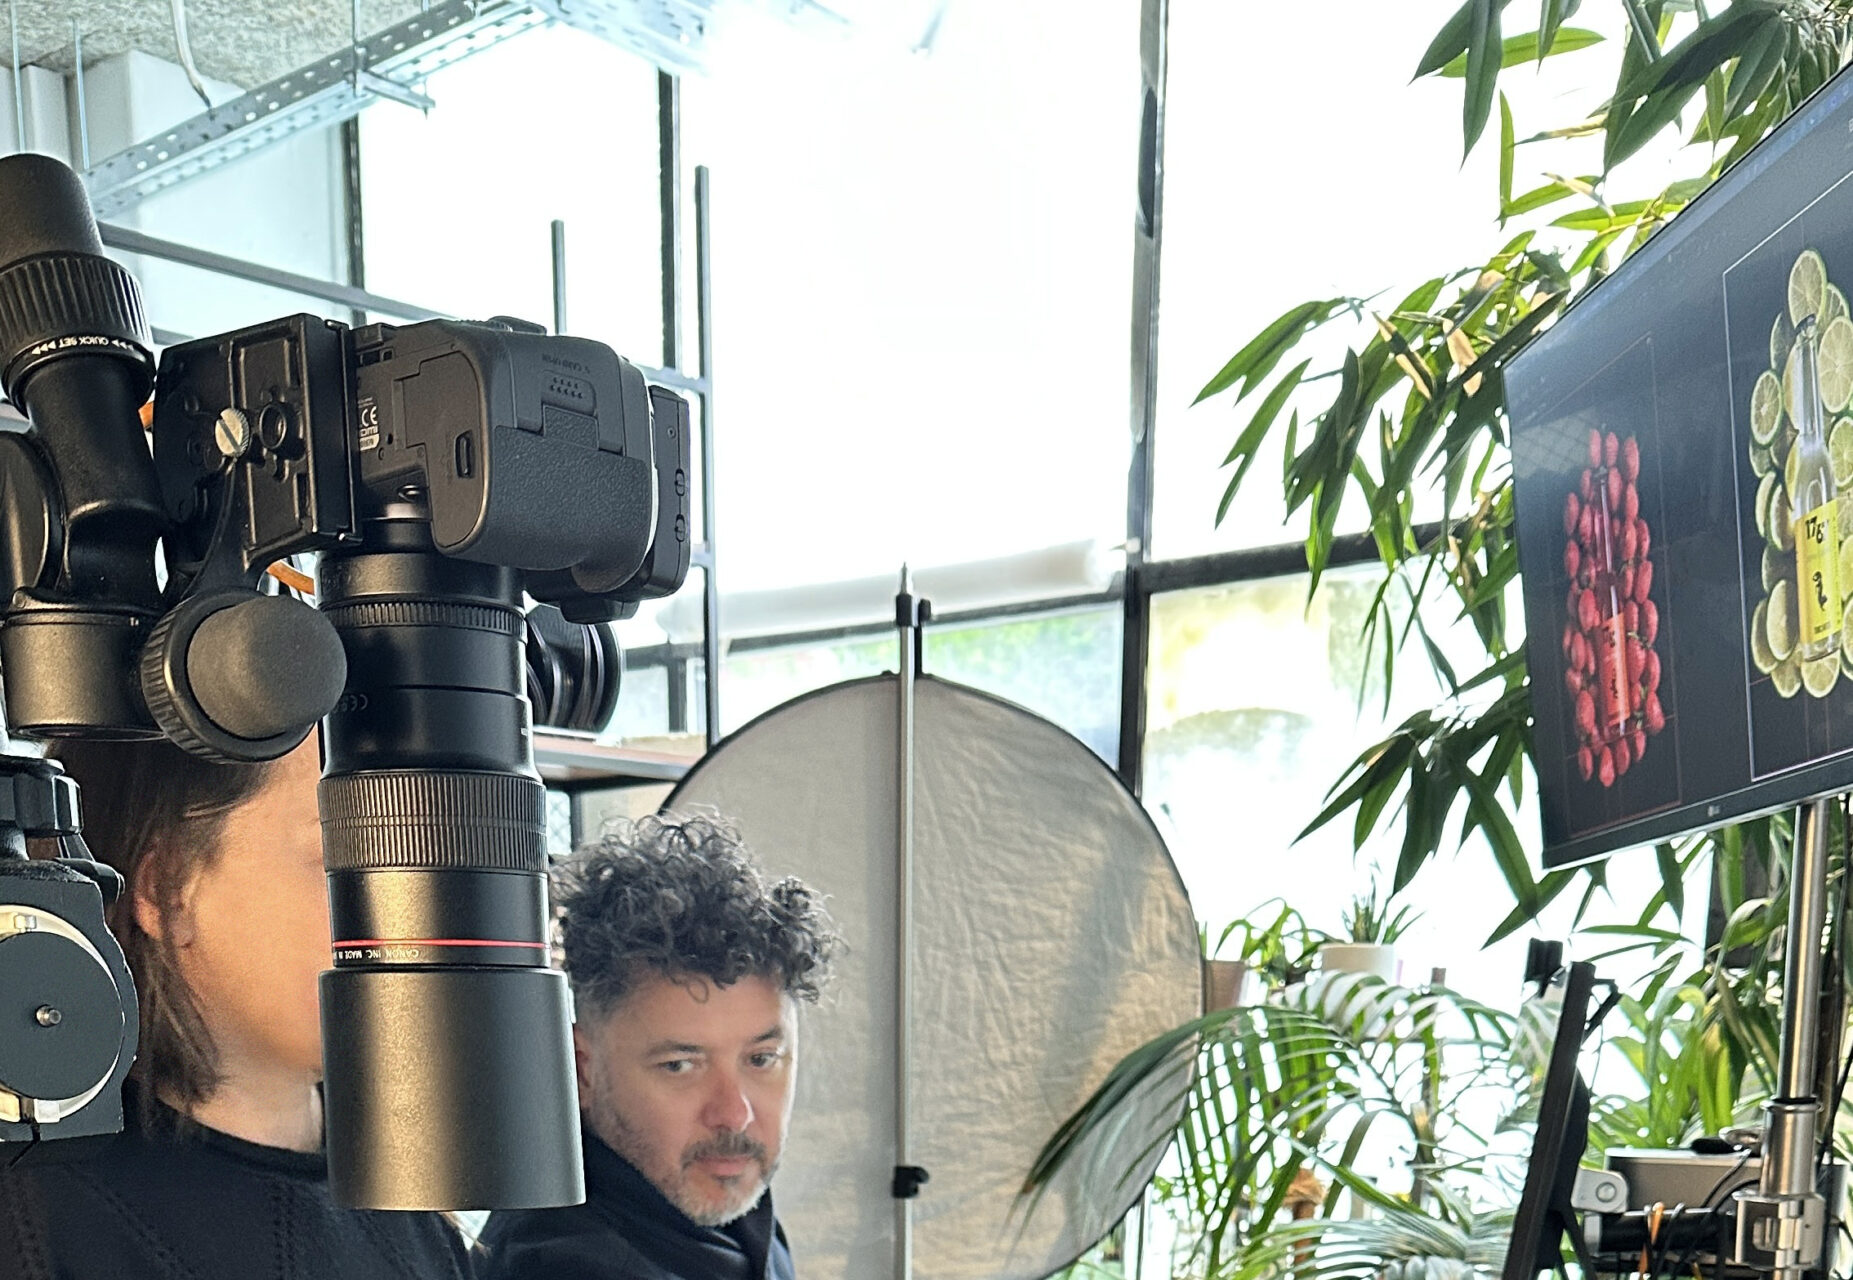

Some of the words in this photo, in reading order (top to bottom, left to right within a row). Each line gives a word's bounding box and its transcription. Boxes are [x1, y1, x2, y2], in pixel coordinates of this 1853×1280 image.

[58, 337, 78, 349] SET
[79, 336, 110, 346] QUICK
[361, 406, 378, 427] CE
[385, 948, 419, 959] CANON
